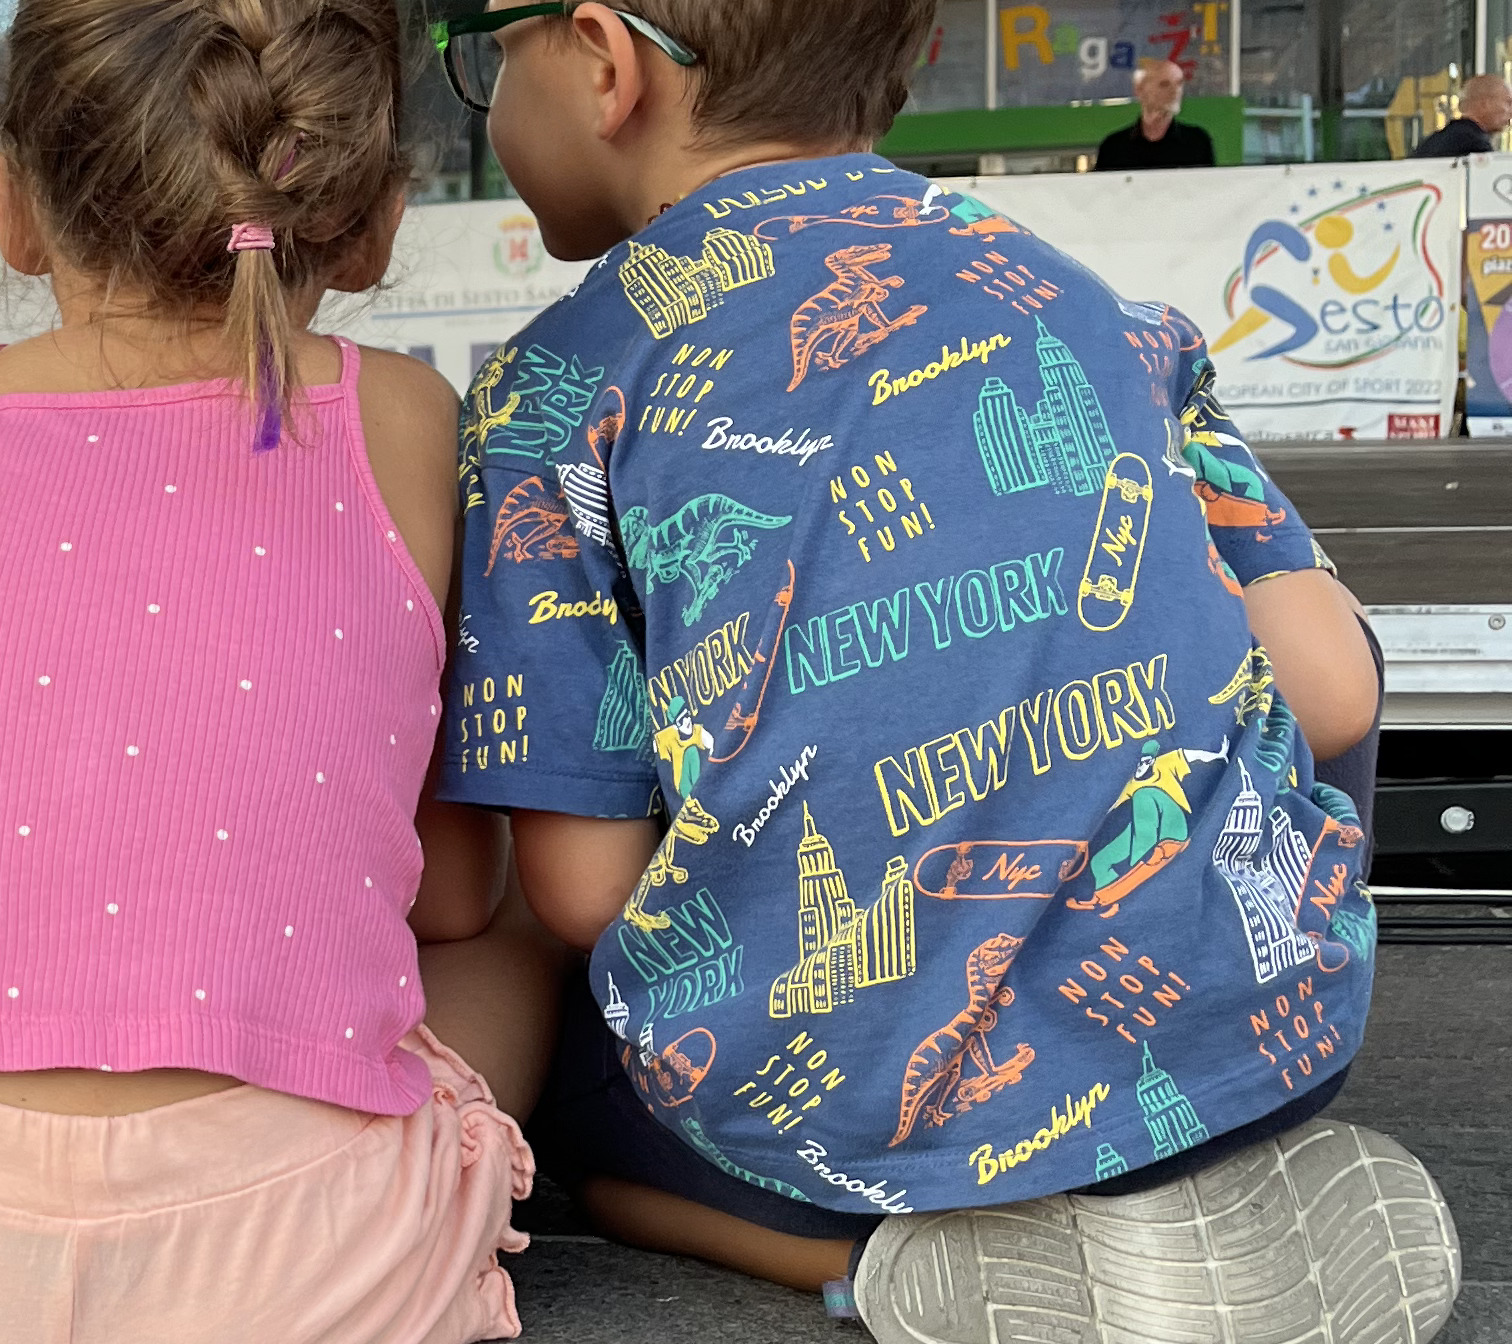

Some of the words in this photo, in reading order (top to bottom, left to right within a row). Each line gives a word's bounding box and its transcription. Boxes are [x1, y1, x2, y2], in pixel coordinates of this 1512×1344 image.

[1480, 223, 1512, 250] 20
[672, 343, 734, 371] NON
[869, 333, 1012, 406] Brooklyn
[650, 372, 715, 404] STOP
[1287, 379, 1325, 397] CITY
[1354, 377, 1401, 396] SPORT
[639, 405, 698, 436] FUN!
[702, 416, 834, 467] Brooklyn
[830, 450, 898, 504] NON
[838, 478, 916, 536] STOP
[857, 502, 937, 563] FUN!
[463, 674, 523, 708] NON
[460, 706, 527, 744] STOP
[461, 735, 529, 774] FUN!
[732, 745, 818, 848] Brooklyn
[1058, 937, 1130, 1005] NON
[1085, 954, 1162, 1027] STOP
[1116, 970, 1192, 1045] FUN!
[1250, 976, 1314, 1037] NON
[1258, 1000, 1324, 1066] STOP
[756, 1054, 822, 1112] STOP
[787, 1031, 846, 1092] NON
[1282, 1024, 1342, 1090] FUN!
[734, 1081, 803, 1136] FUN!
[968, 1082, 1111, 1185] Brooklyn
[796, 1139, 914, 1214] Brookly
